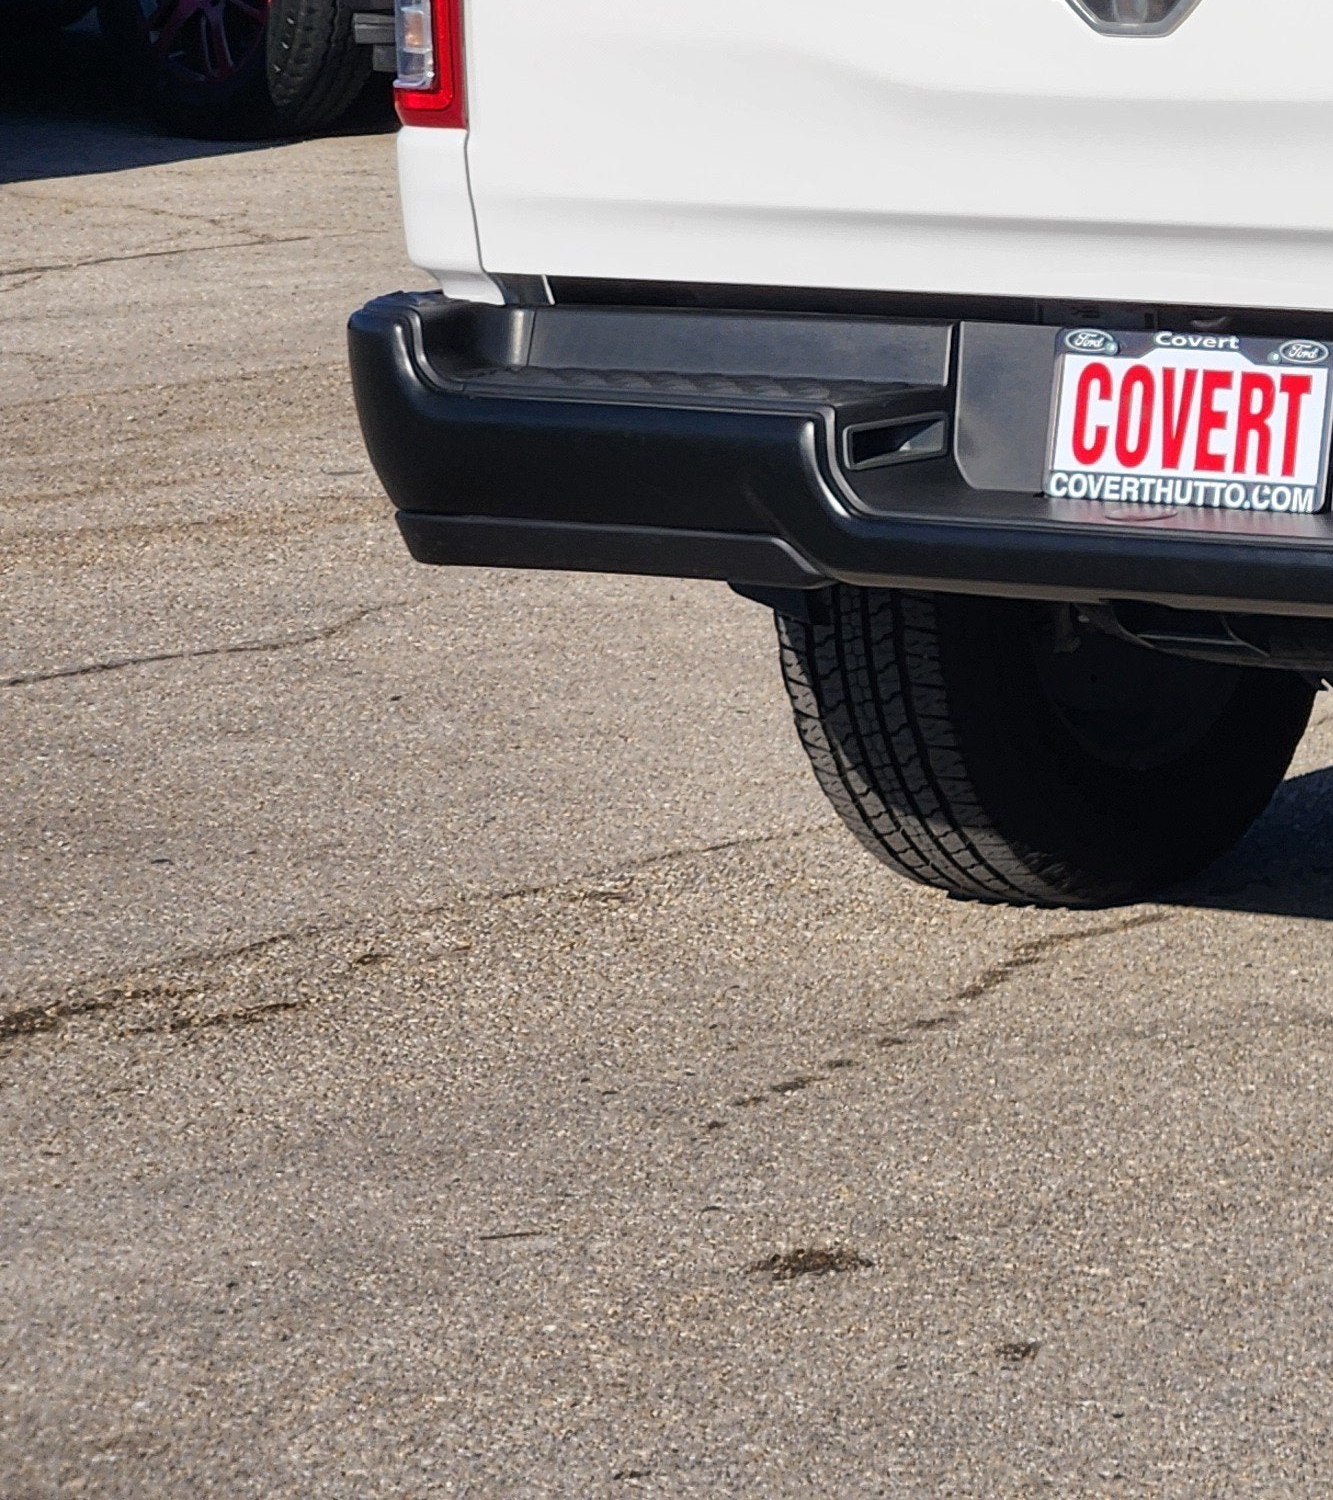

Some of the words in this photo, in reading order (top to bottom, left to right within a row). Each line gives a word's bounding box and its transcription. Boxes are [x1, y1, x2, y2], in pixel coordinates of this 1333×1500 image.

[1155, 331, 1240, 349] Covert
[1072, 362, 1313, 477] COVERT
[1049, 473, 1315, 512] COVERTHUTTO.COM
